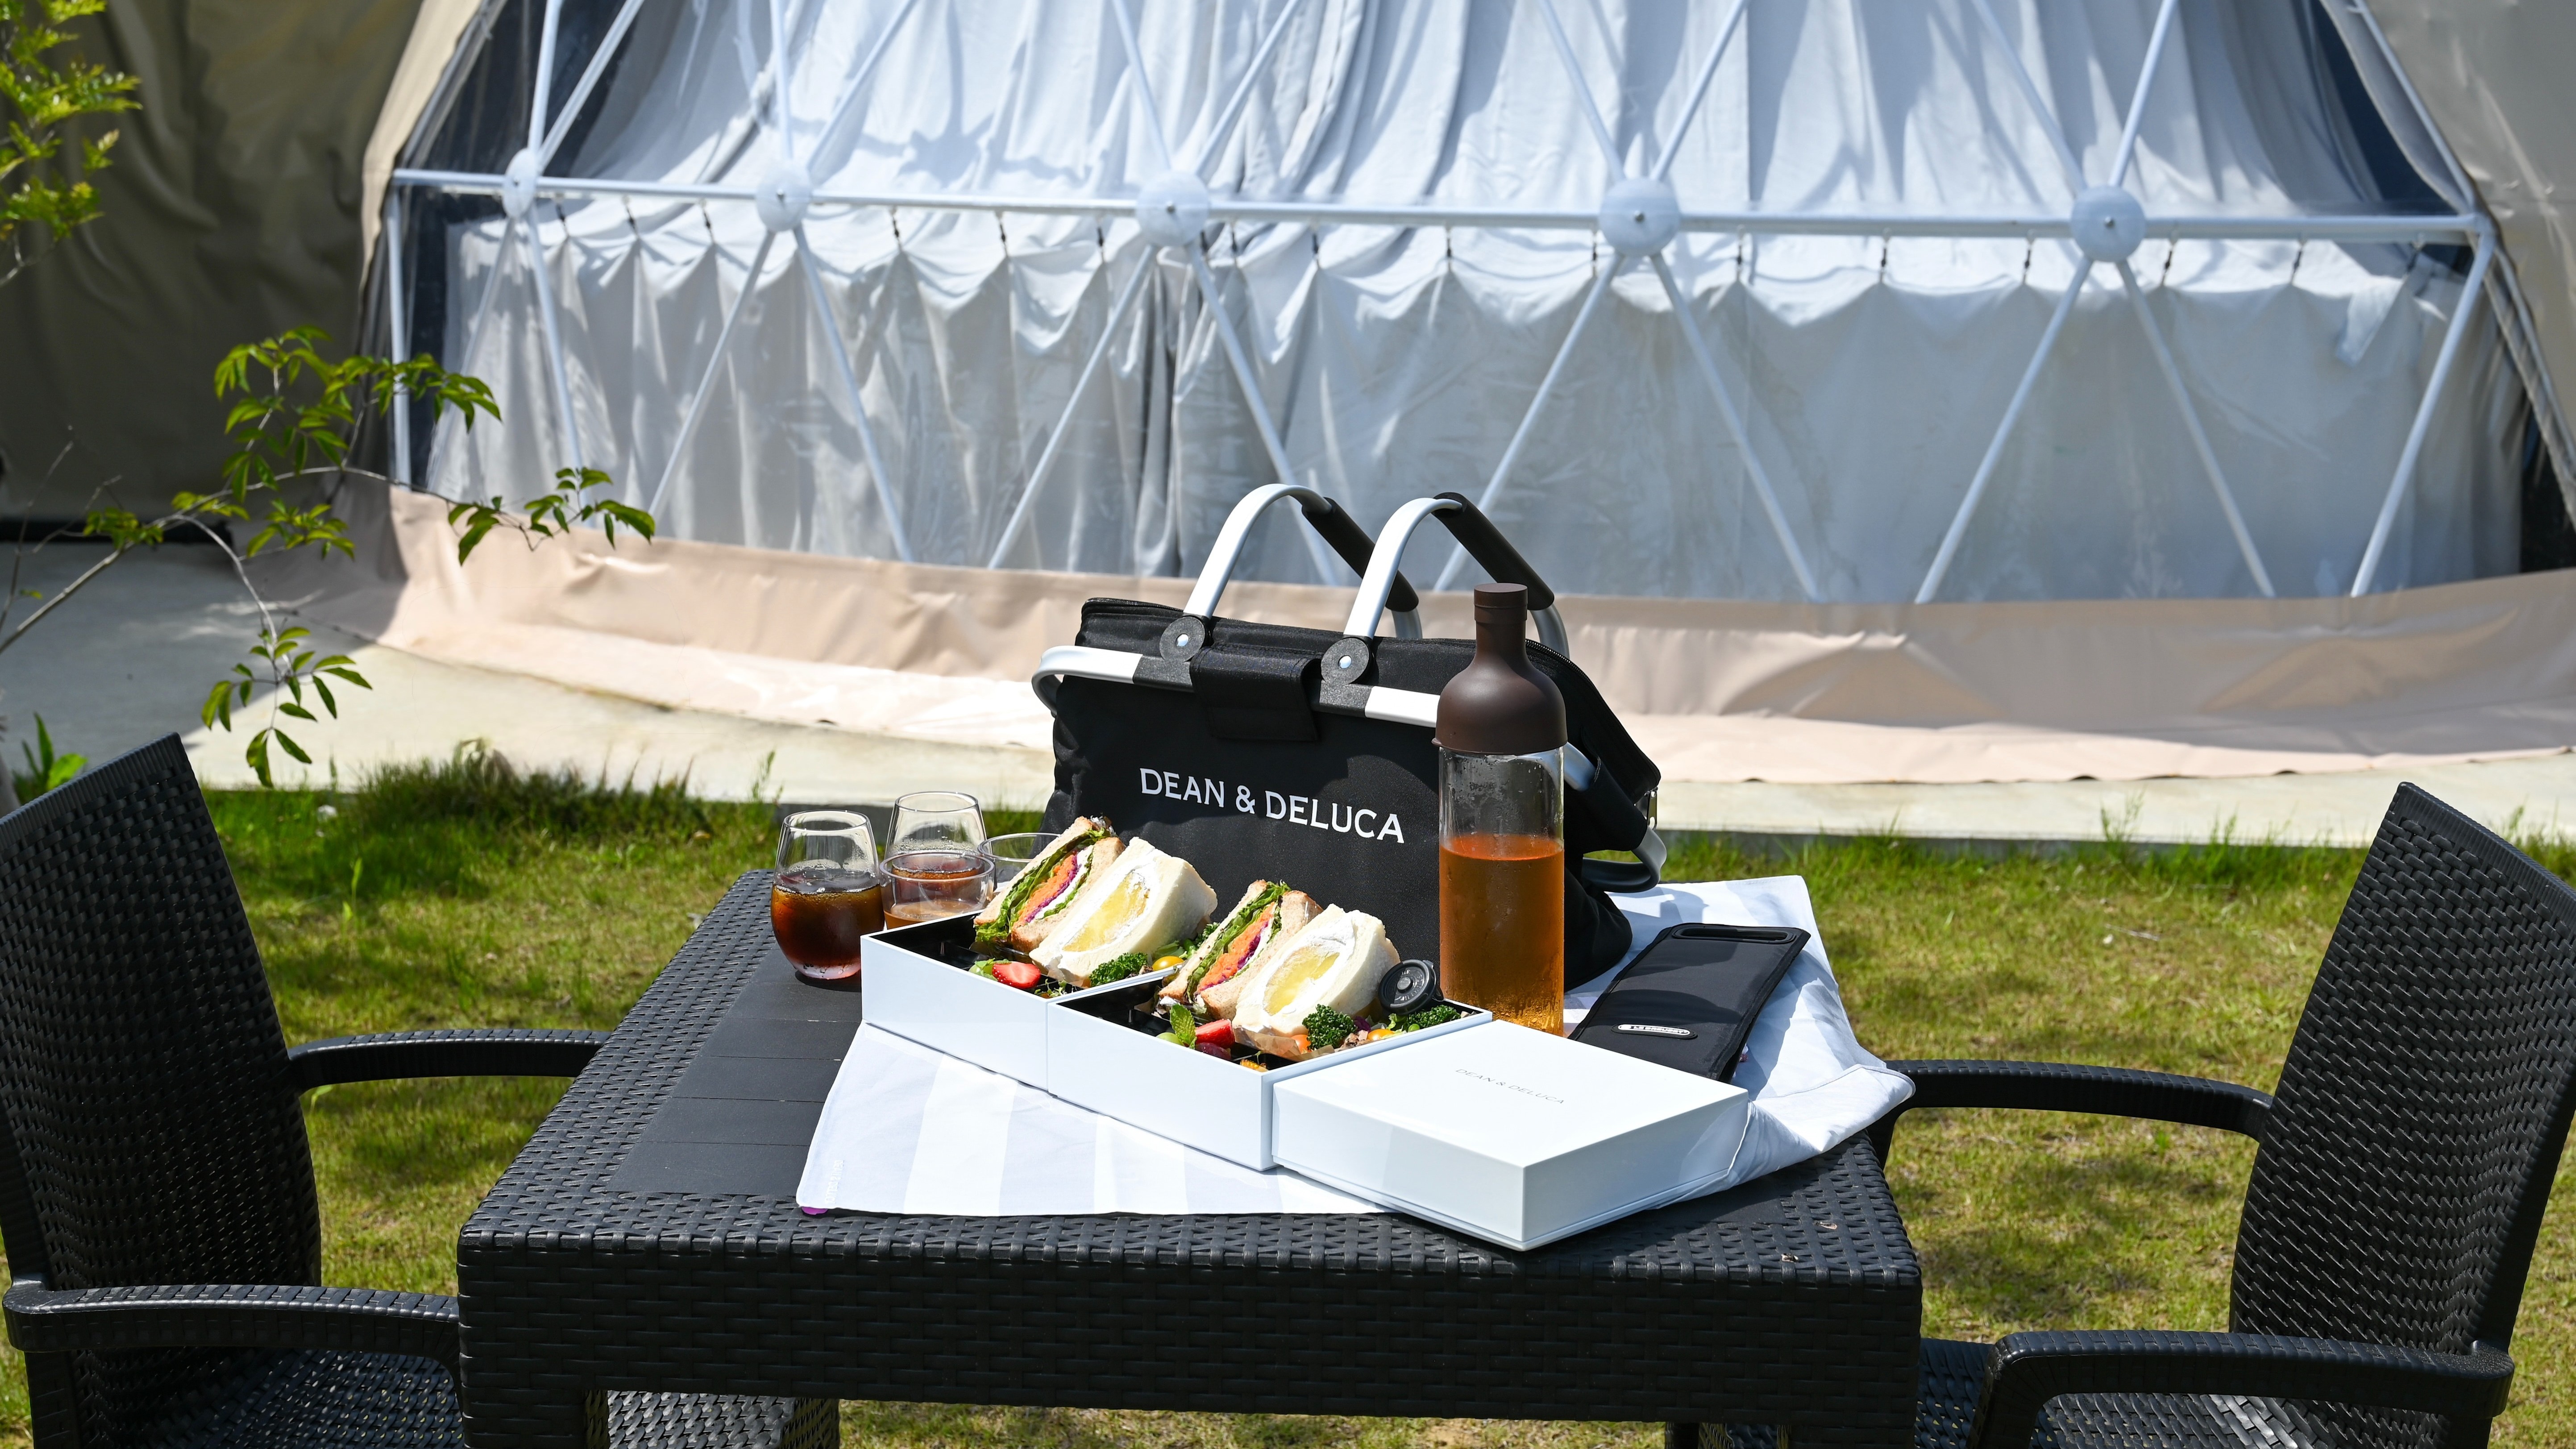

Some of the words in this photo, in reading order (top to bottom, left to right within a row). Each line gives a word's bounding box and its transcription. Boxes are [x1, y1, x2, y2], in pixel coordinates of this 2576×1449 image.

[1139, 768, 1225, 807] DEAN
[1236, 785, 1255, 814] &
[1265, 790, 1405, 843] DELUCA
[1456, 1069, 1495, 1082] DEAN
[1508, 1085, 1564, 1104] DELUCA
